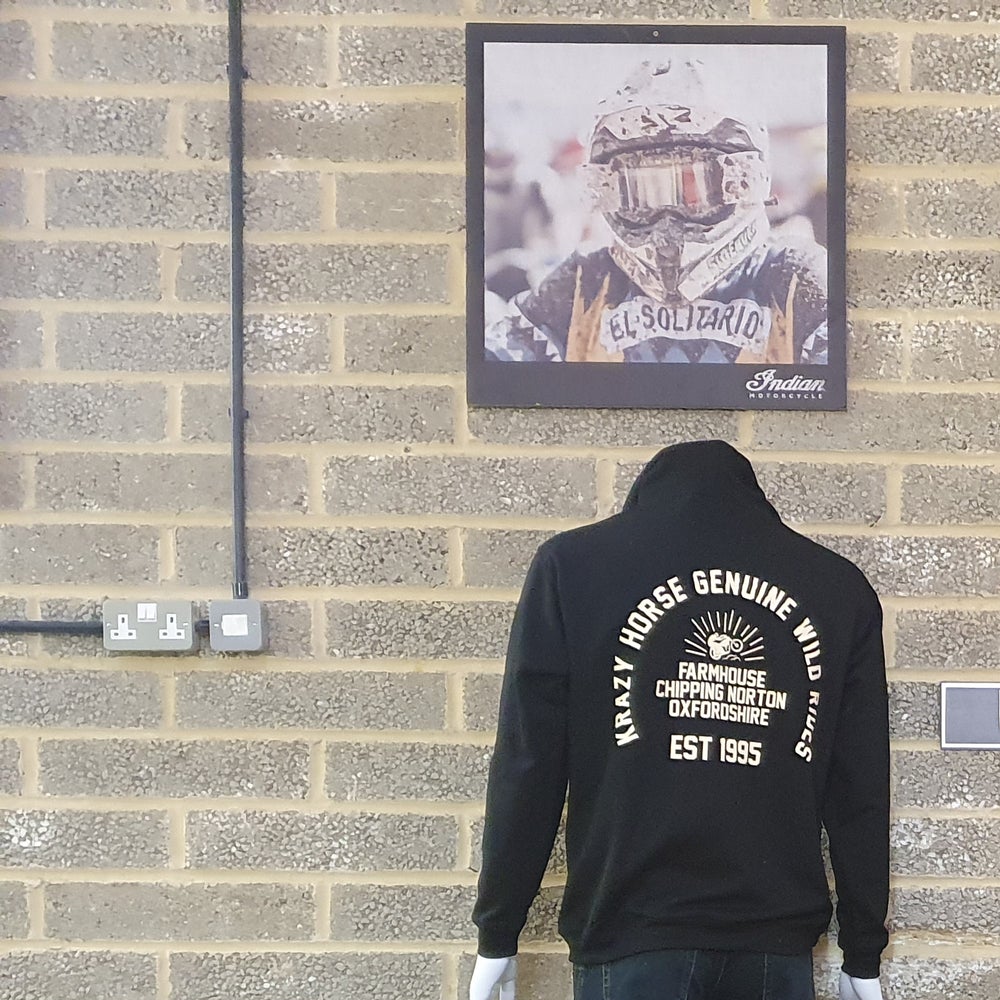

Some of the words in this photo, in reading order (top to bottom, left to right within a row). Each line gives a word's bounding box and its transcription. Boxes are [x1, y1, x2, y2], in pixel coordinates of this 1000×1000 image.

[610, 310, 637, 342] EL
[641, 303, 760, 340] SOLITARIO
[745, 369, 826, 392] Indian
[692, 568, 798, 622] GENUINE
[619, 576, 688, 651] HORSE
[792, 617, 822, 681] WILD
[678, 661, 767, 688] FARMHOUSE
[613, 656, 640, 747] KRAZY
[655, 680, 724, 702] CHIPPING
[727, 685, 787, 711] NORTON
[668, 699, 770, 727] OXFORDSHIRE
[669, 734, 713, 761] EST
[719, 737, 762, 767] 1995
